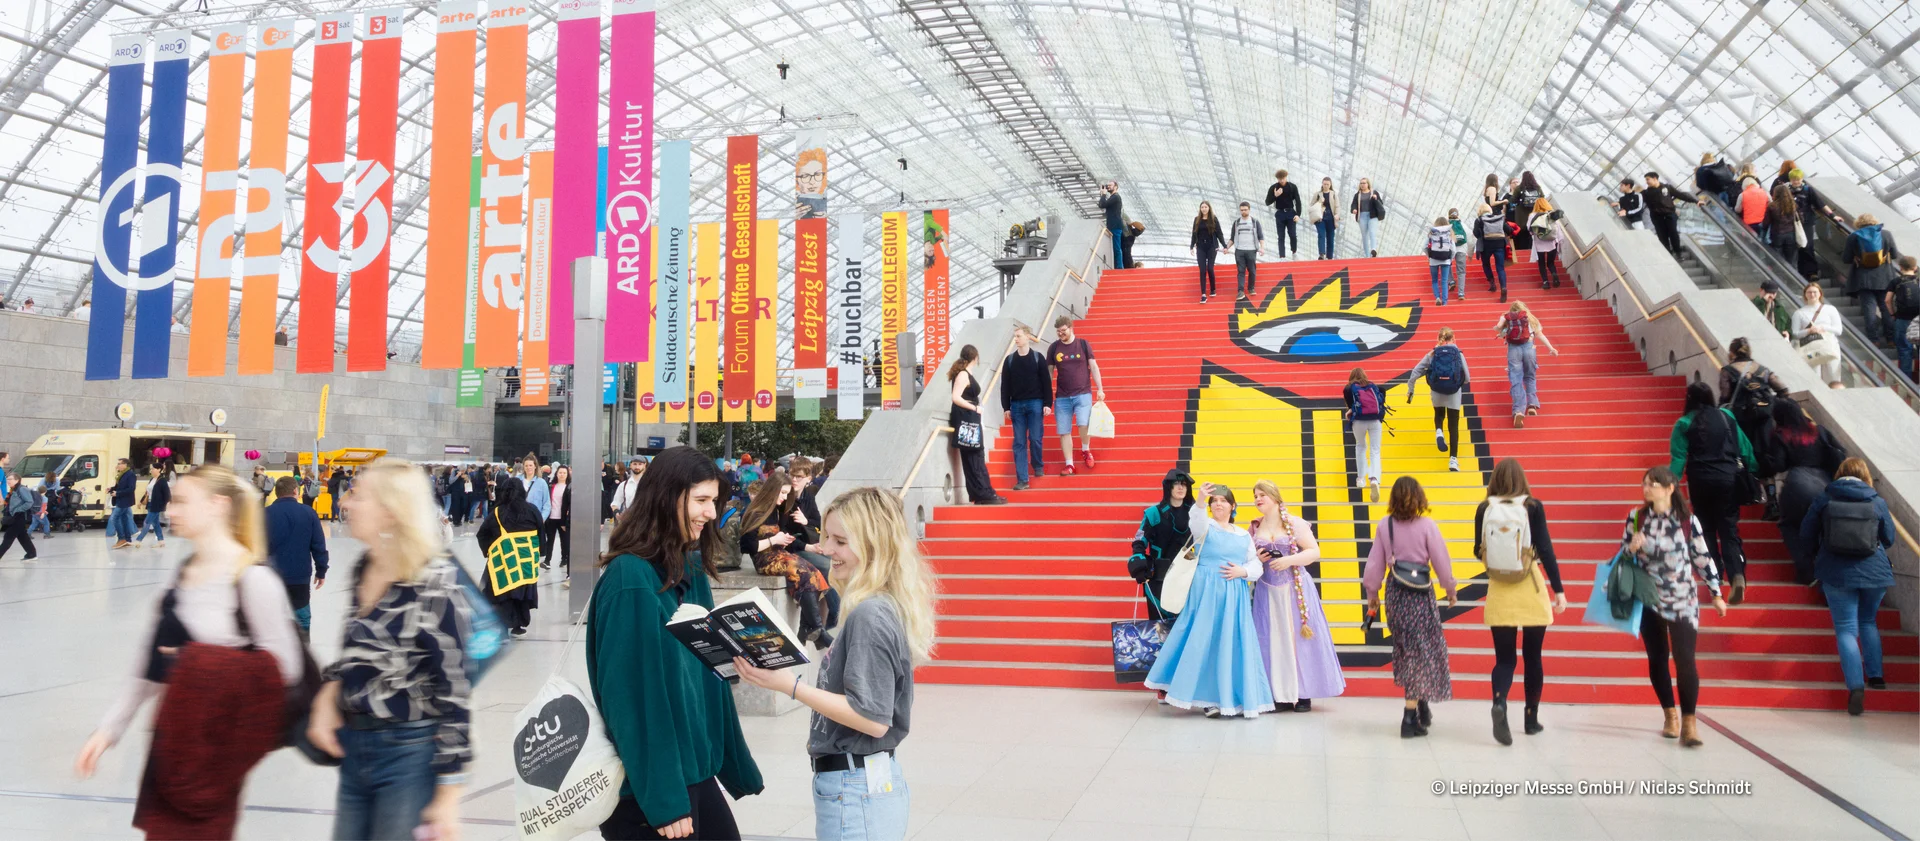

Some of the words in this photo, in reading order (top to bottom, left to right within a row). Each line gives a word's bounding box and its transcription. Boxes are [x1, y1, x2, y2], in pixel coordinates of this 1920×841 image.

[271, 30, 292, 40] ZDF
[440, 12, 475, 24] arte
[490, 6, 526, 18] arte
[114, 48, 131, 57] ARD
[159, 43, 176, 52] ARD
[224, 35, 244, 46] ZDF
[618, 101, 642, 186] Kultur
[481, 101, 526, 310] arte
[536, 202, 547, 236] Kultur
[732, 162, 751, 259] Gesellschaft
[616, 233, 640, 296] ARD
[665, 227, 684, 286] Zeitung
[807, 232, 818, 275] liest
[884, 217, 898, 304] KOLLEGIUM
[469, 244, 480, 340] Deutschlandfunk
[533, 239, 545, 338] Deutschlandfunk
[731, 263, 749, 313] Offene
[840, 257, 862, 365] #buchbar
[926, 289, 936, 322] LESEN
[937, 276, 946, 331] LIEBSTEN?
[662, 286, 677, 383] Süddeutsche
[800, 278, 824, 353] Leipzig
[884, 307, 898, 332] INS
[927, 326, 936, 345] WO
[731, 319, 748, 373] Forum
[884, 334, 898, 385] KOMM
[927, 348, 936, 373] UND
[938, 334, 946, 353] AM
[544, 743, 579, 765] Senftenberg
[547, 735, 579, 754] Universität
[520, 805, 546, 823] DUAL
[545, 769, 604, 811] STUDIEREN
[523, 822, 541, 836] MIT
[540, 776, 610, 828] PERSPEKTIVE
